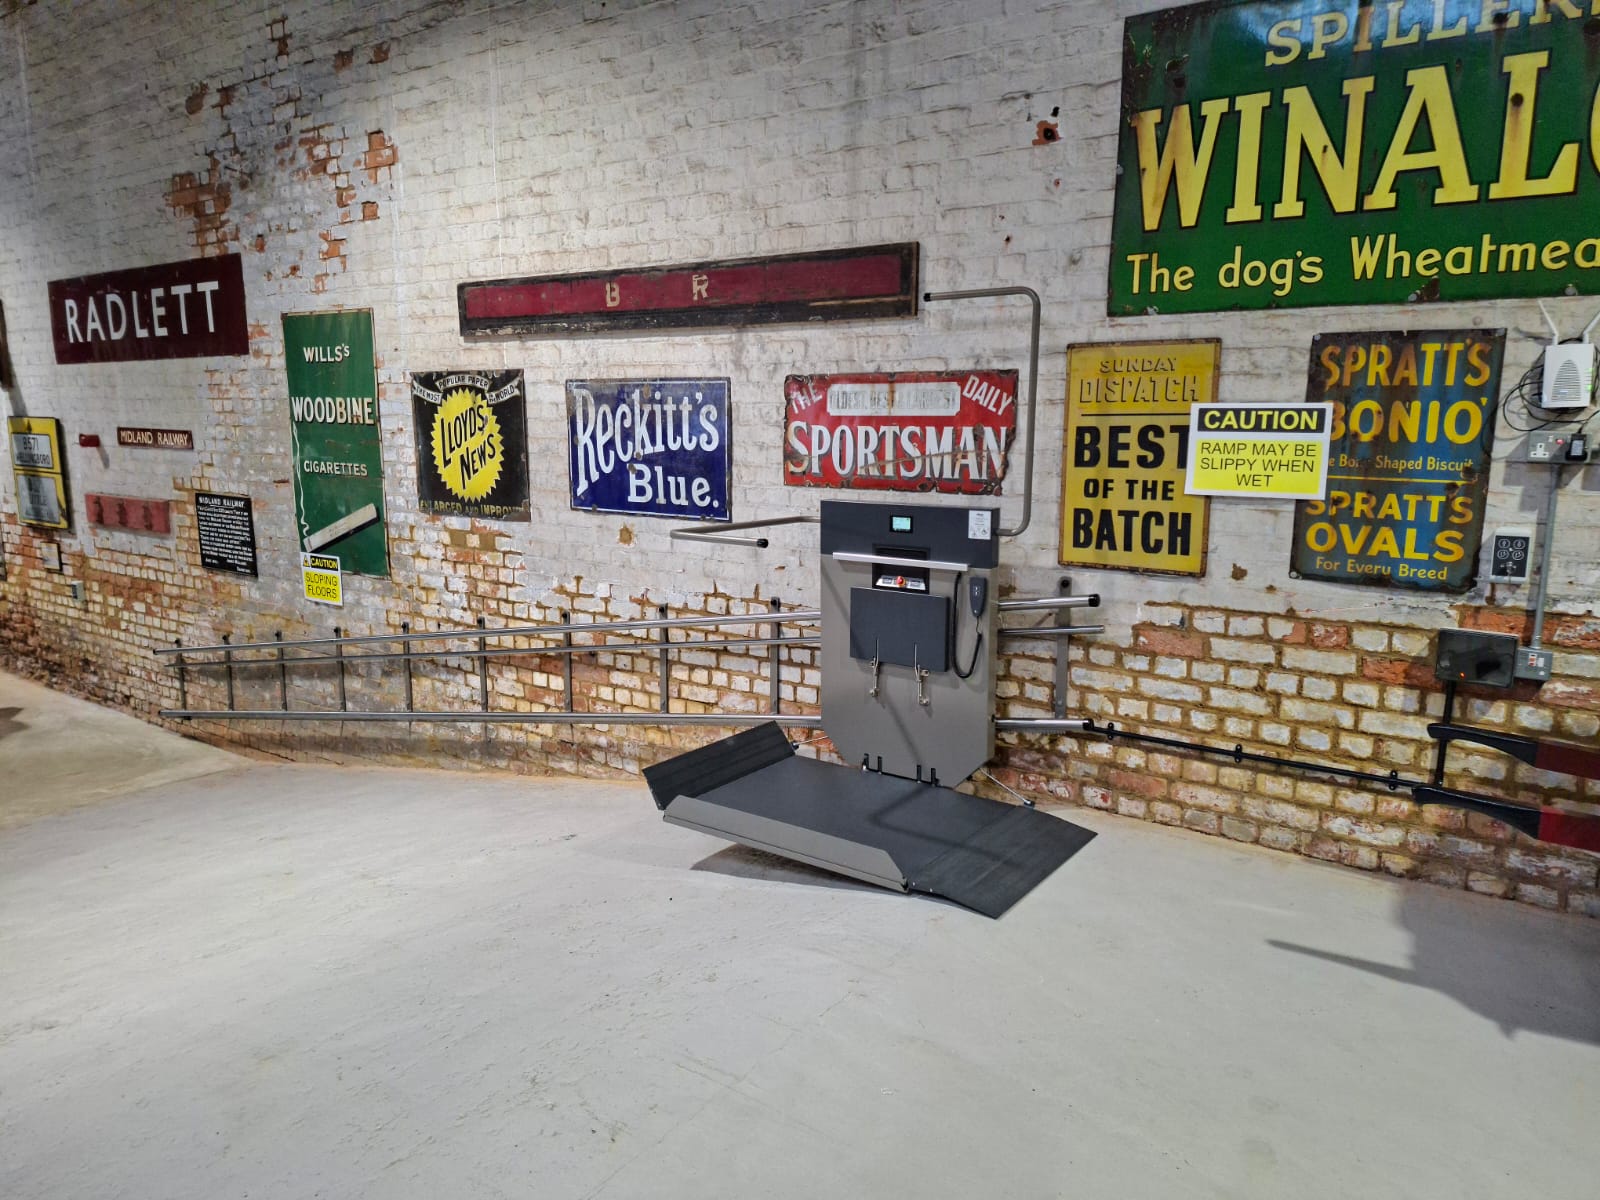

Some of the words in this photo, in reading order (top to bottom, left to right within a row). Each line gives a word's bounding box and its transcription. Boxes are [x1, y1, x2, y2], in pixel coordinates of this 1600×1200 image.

[1265, 0, 1600, 67] SPILLE
[1131, 50, 1600, 231] WINAL
[1126, 253, 1195, 294] The
[1218, 245, 1323, 297] dog's
[605, 282, 621, 307] B
[691, 274, 709, 301] R
[64, 280, 220, 344] RADLETT
[1099, 357, 1177, 373] SUNDAY
[1320, 338, 1492, 391] SPRATT'S
[439, 375, 465, 389] POPULAR
[467, 375, 489, 388] PAPER
[496, 384, 515, 402] WORLD
[962, 374, 1013, 416] DAILY
[1079, 375, 1199, 403] DISPATCH
[291, 396, 375, 425] WOODBINE
[426, 391, 441, 402] MOST
[789, 382, 823, 414] THE
[1203, 409, 1318, 431] CAUTION
[120, 430, 153, 444] MIDLAND
[157, 432, 188, 446] RAILWAY
[572, 387, 720, 496] Reckitt's
[787, 420, 1008, 480] SPORTSMAN
[1074, 424, 1191, 469] BEST
[1200, 442, 1247, 456] RAMP
[1252, 443, 1289, 457] MAY
[1294, 444, 1317, 457] BE
[303, 460, 368, 476] CIGARETTES
[460, 433, 496, 490] NEWS
[1200, 457, 1257, 471] SLIPPY
[1262, 459, 1315, 473] WHEN
[1375, 455, 1422, 473] Shaped
[627, 463, 719, 508] Blue.
[1084, 478, 1114, 499] OF
[1126, 480, 1175, 501] THE
[1237, 474, 1273, 487] WET
[1072, 508, 1192, 556] BATCH
[1305, 522, 1465, 562] OVALS
[310, 557, 338, 570] CAUTION
[1316, 556, 1341, 570] For
[1399, 563, 1448, 580] Breed
[305, 572, 338, 587] SLOPING
[307, 585, 337, 599] FLOORS
